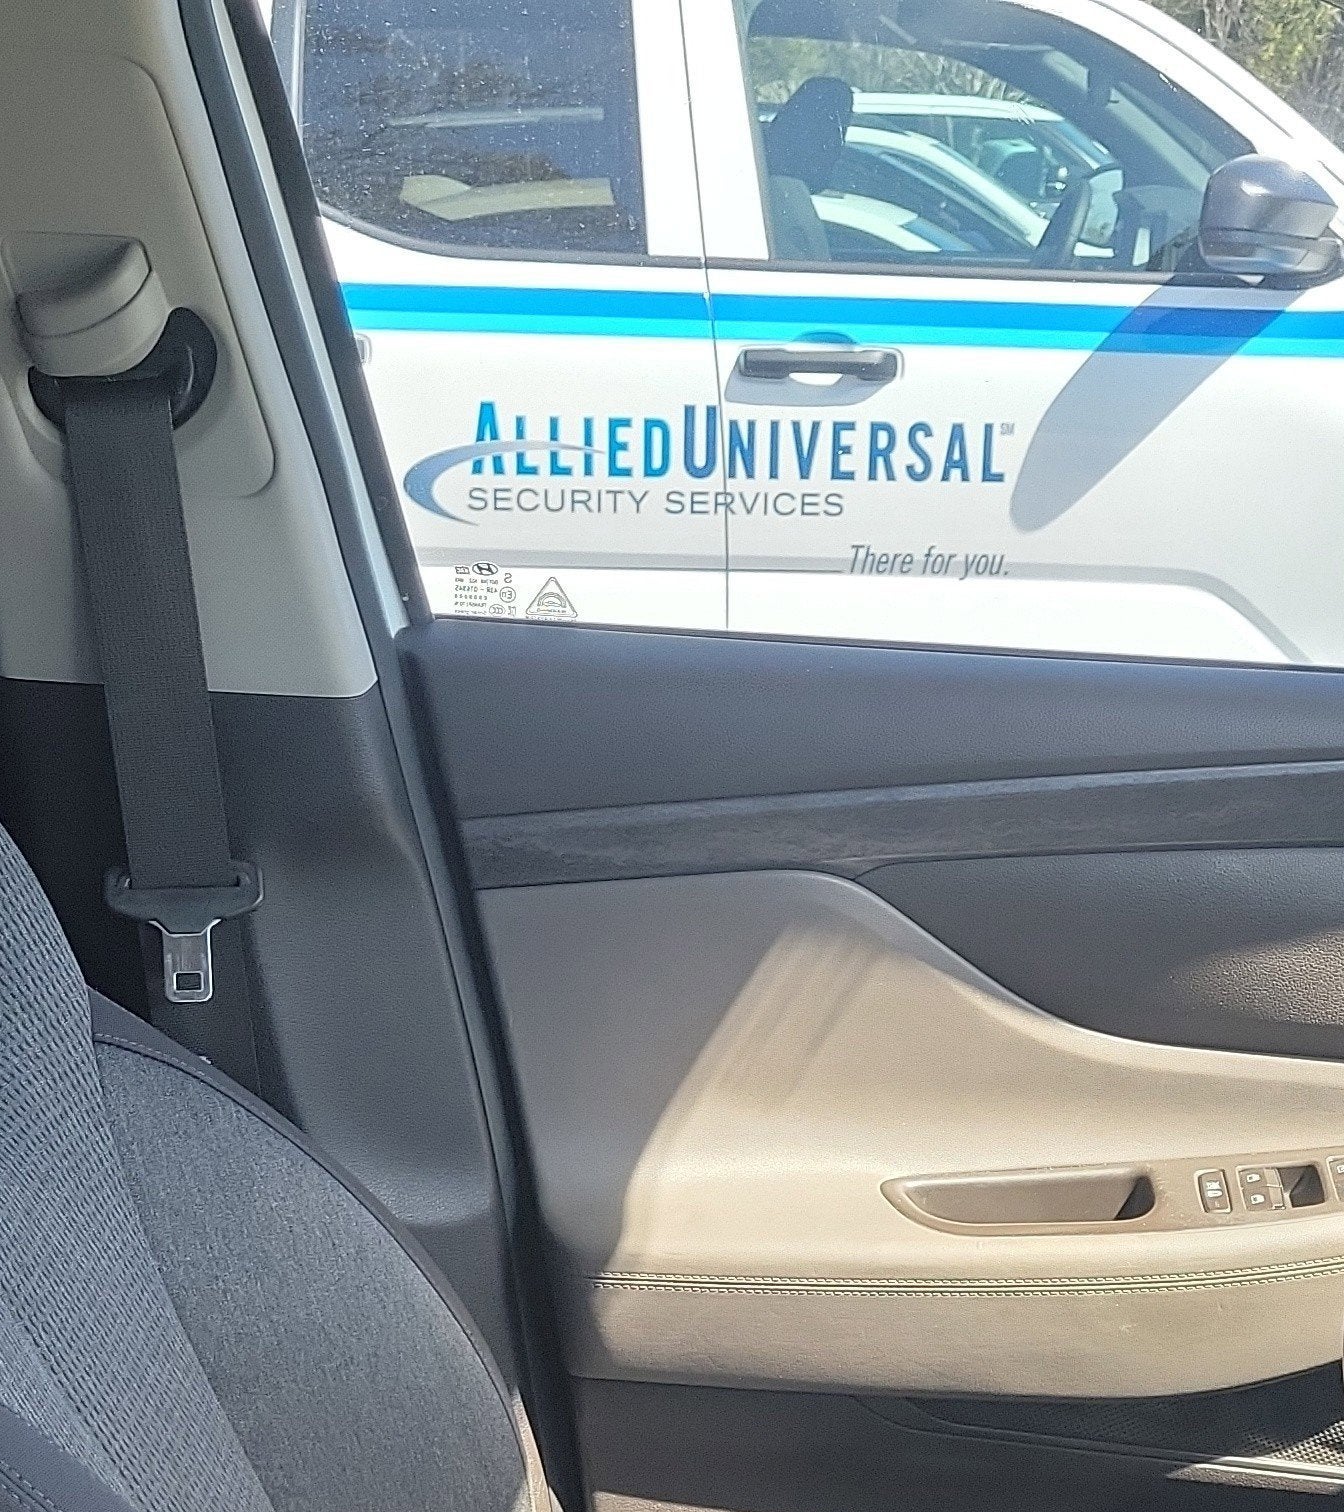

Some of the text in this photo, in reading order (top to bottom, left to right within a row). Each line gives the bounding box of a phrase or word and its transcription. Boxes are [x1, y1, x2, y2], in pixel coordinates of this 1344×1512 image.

[467, 486, 845, 517] SECURITY SERVICES
[849, 544, 1010, 580] There for you.
